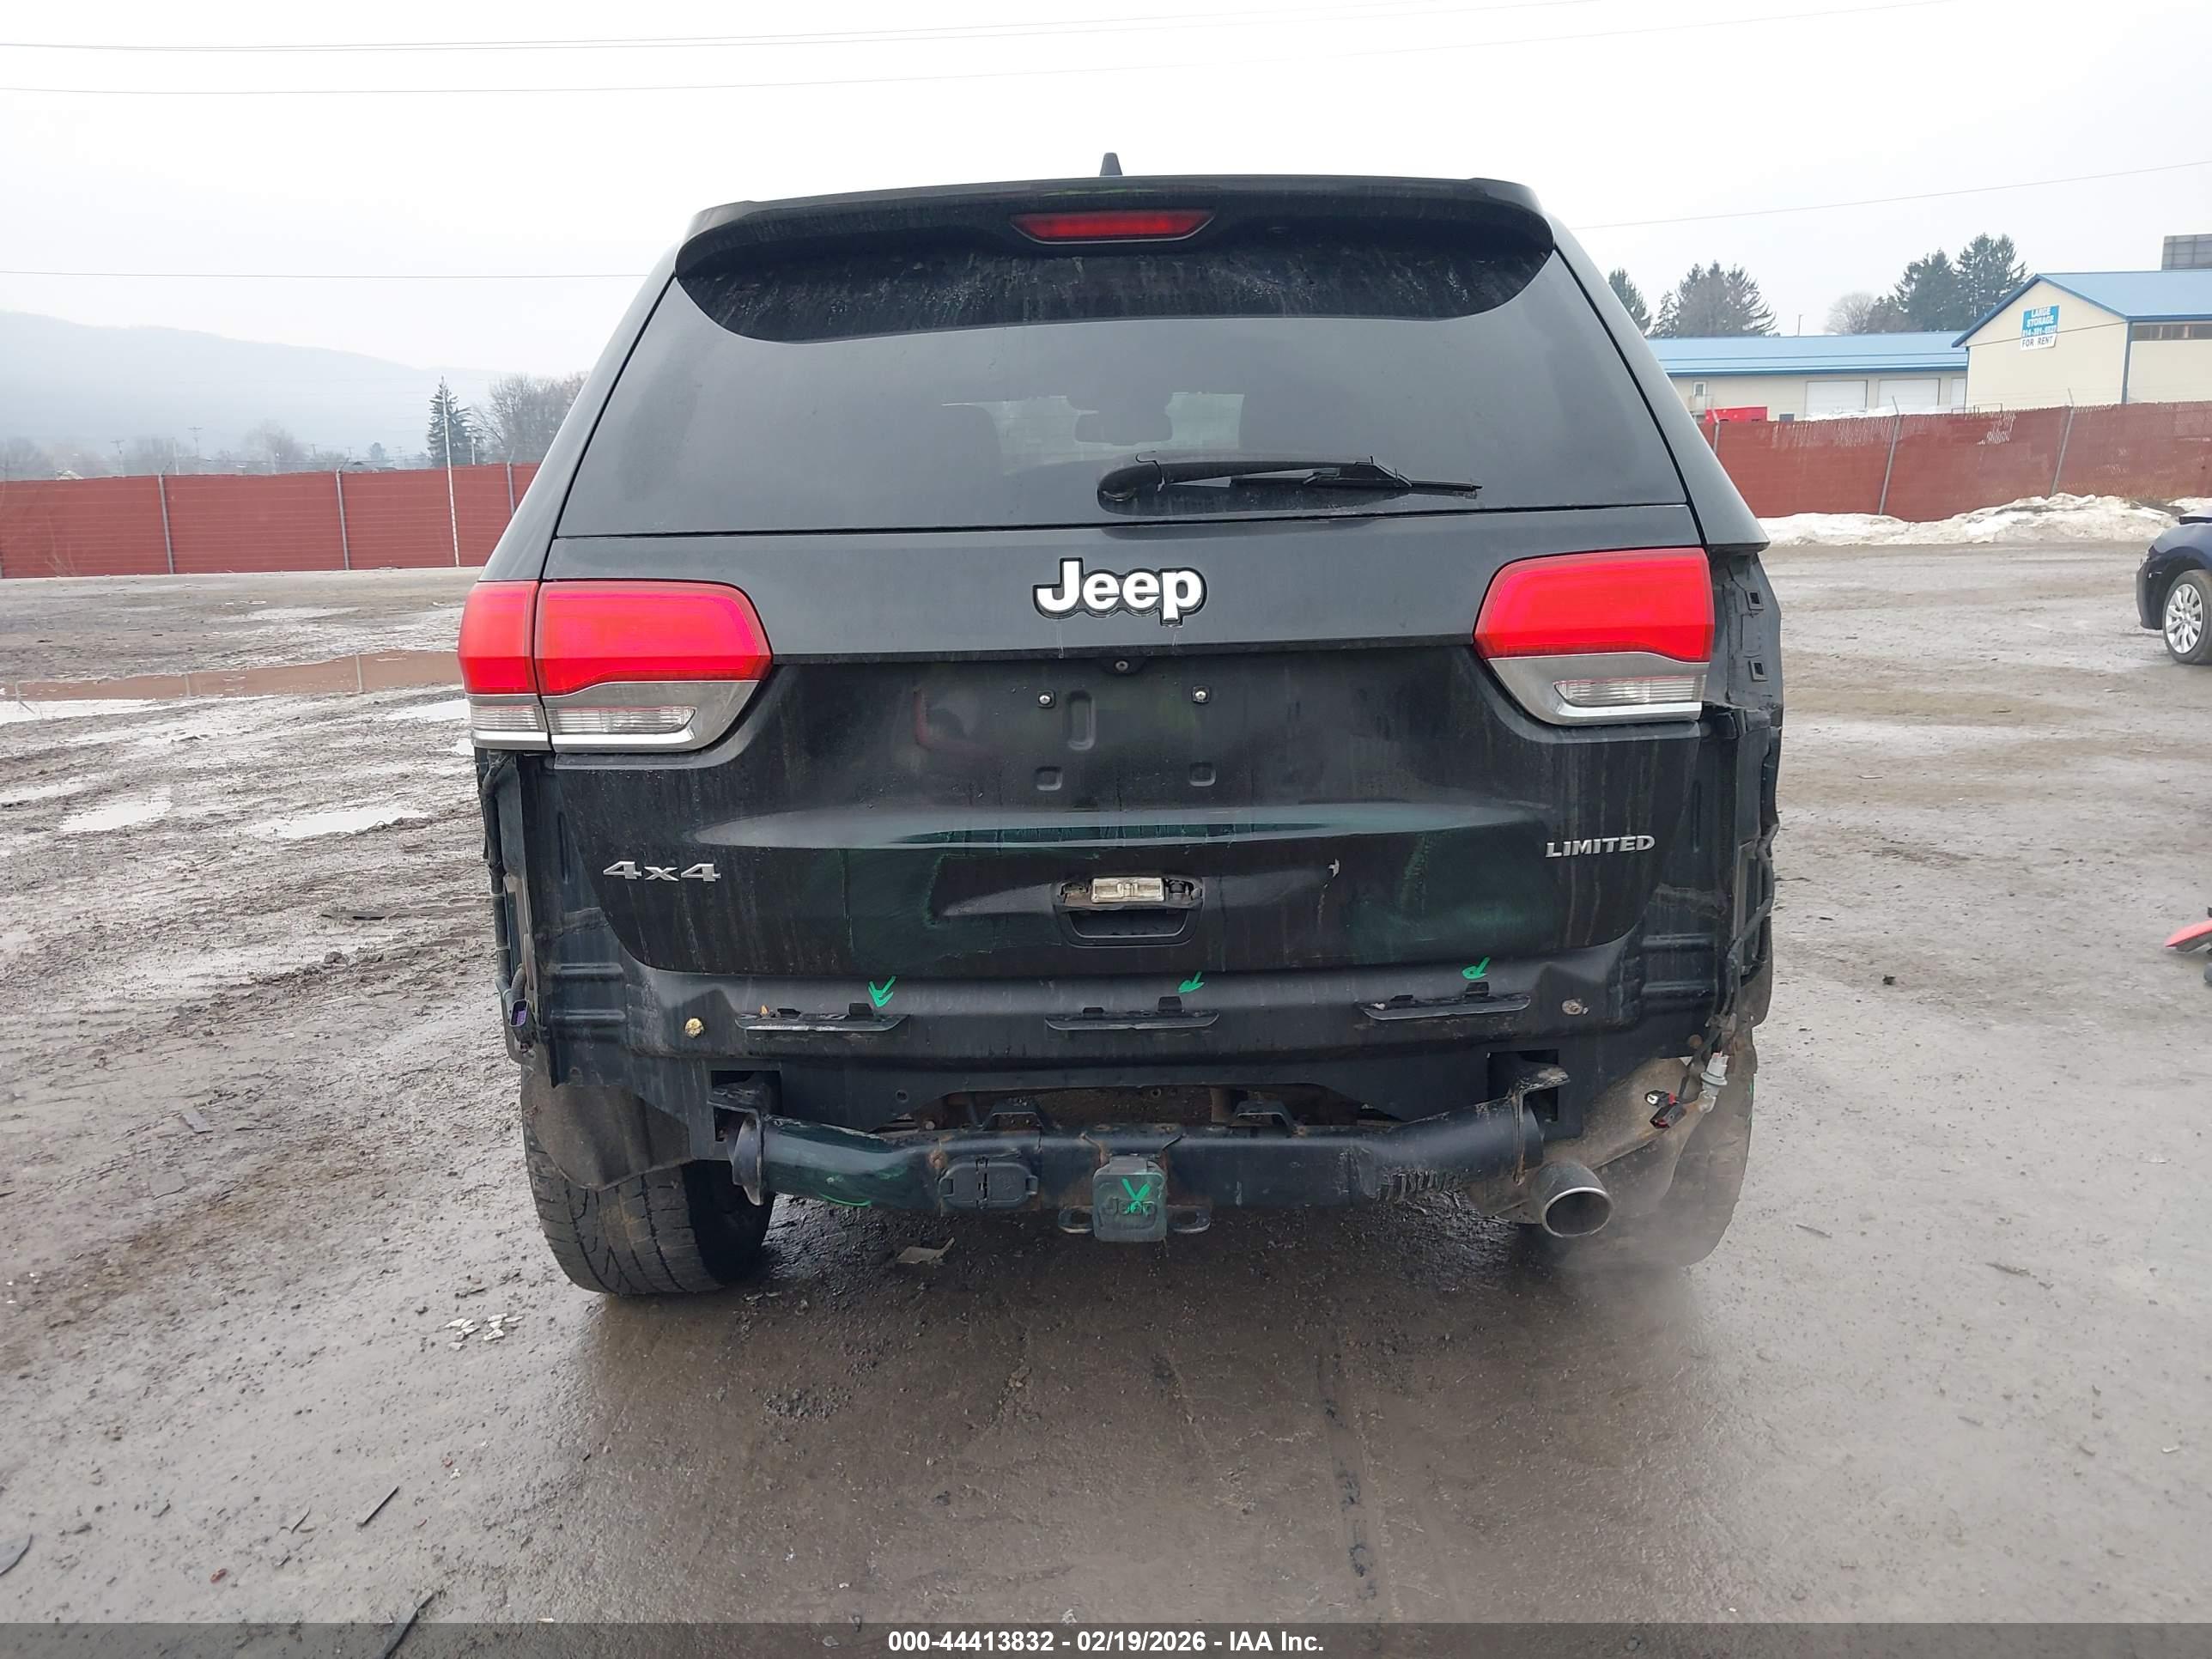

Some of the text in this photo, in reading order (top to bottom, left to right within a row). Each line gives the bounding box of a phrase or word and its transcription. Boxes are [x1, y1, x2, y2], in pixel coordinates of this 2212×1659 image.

[2027, 314, 2054, 327] STORAGE
[2022, 336, 2052, 348] FOR RENT
[1034, 558, 1206, 624] Jeep
[1546, 835, 1656, 858] LIMITED
[603, 860, 722, 883] 4x4
